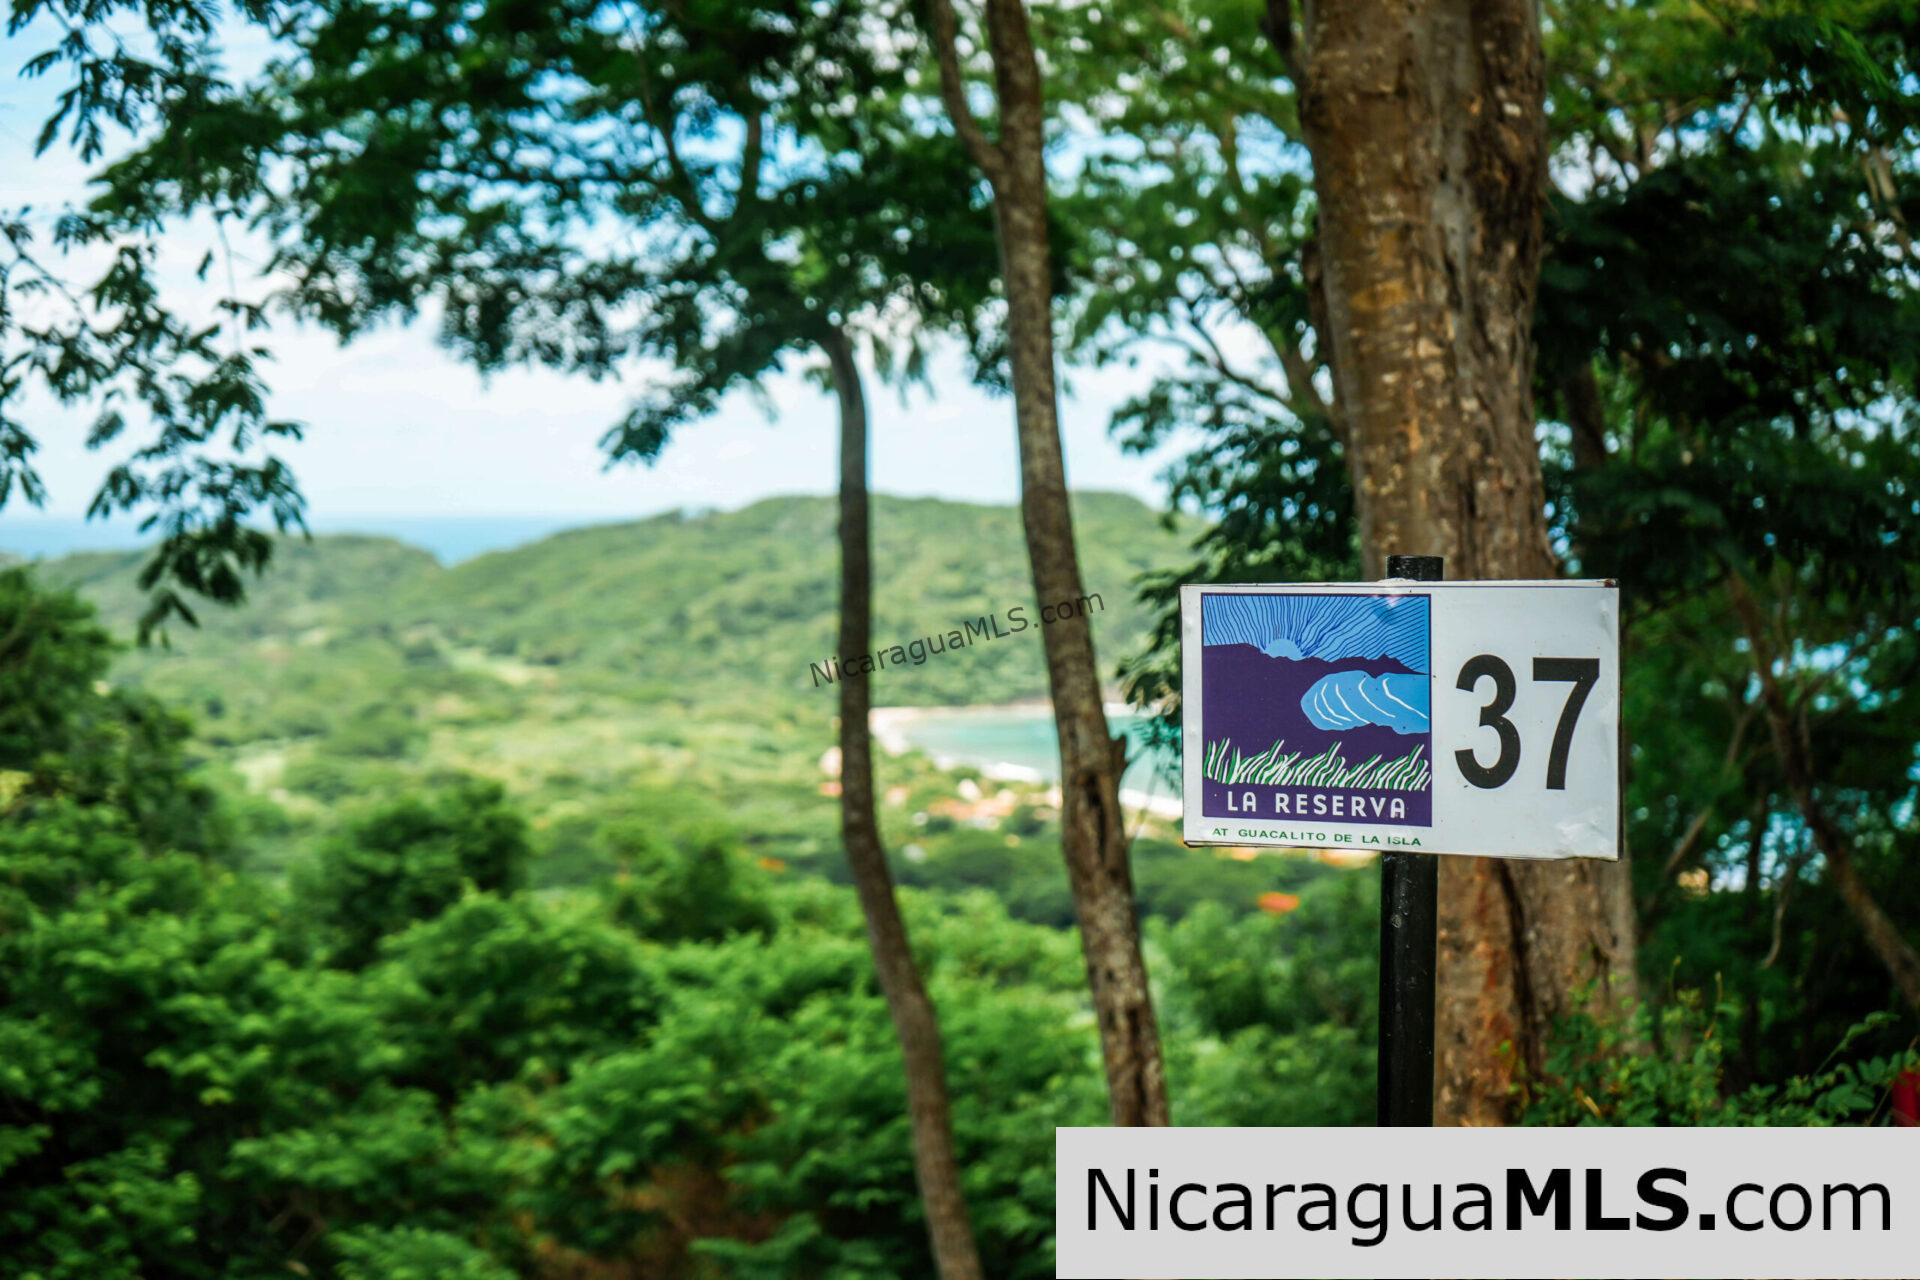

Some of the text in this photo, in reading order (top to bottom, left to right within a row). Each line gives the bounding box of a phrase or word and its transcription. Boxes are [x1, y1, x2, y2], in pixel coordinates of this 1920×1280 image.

[1455, 654, 1600, 790] 37
[1227, 790, 1405, 819] LA RESERVA
[1212, 827, 1421, 846] AT GUACALITO DE LA ISLA
